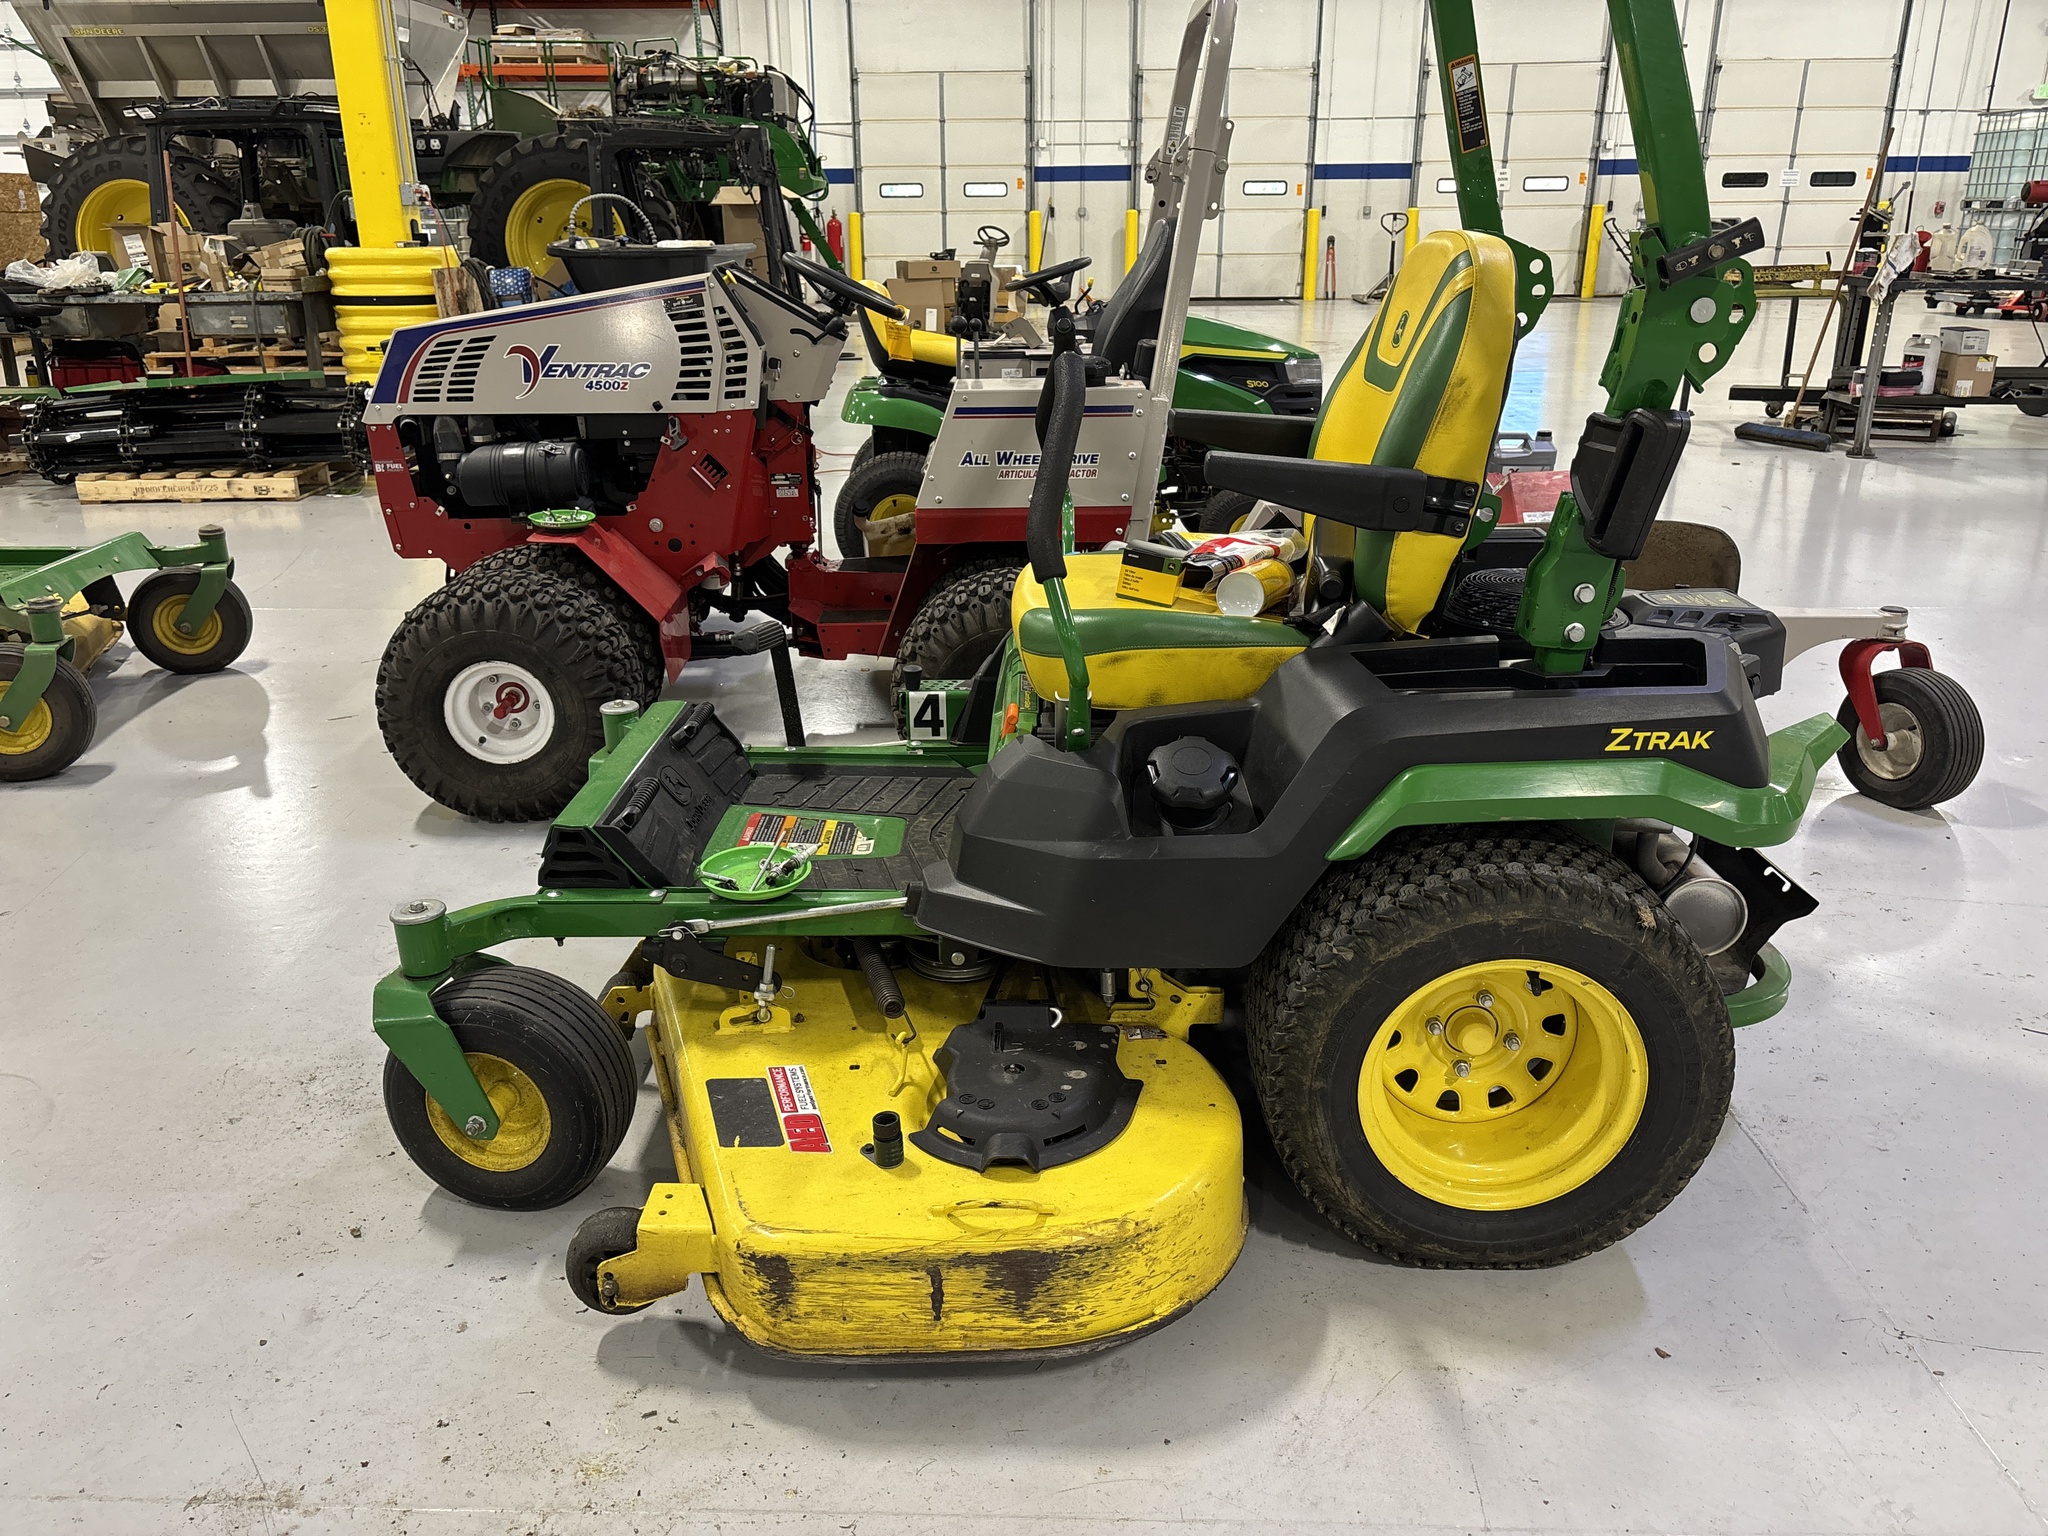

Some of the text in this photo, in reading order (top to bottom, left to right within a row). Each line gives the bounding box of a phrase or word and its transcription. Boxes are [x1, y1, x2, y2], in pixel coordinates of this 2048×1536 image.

[504, 344, 651, 399] VENTRAC
[1246, 380, 1269, 388] S100
[996, 451, 1041, 466] WHEE
[1072, 454, 1100, 464] RIVE
[1000, 469, 1098, 479] ARTICULA ACTOR
[914, 694, 944, 737] 4
[1604, 728, 1715, 751] ZTRAK
[772, 1068, 794, 1112] PERFORMANCE
[788, 1067, 809, 1110] FUEL SYSTEMS
[783, 1114, 832, 1153] AED
